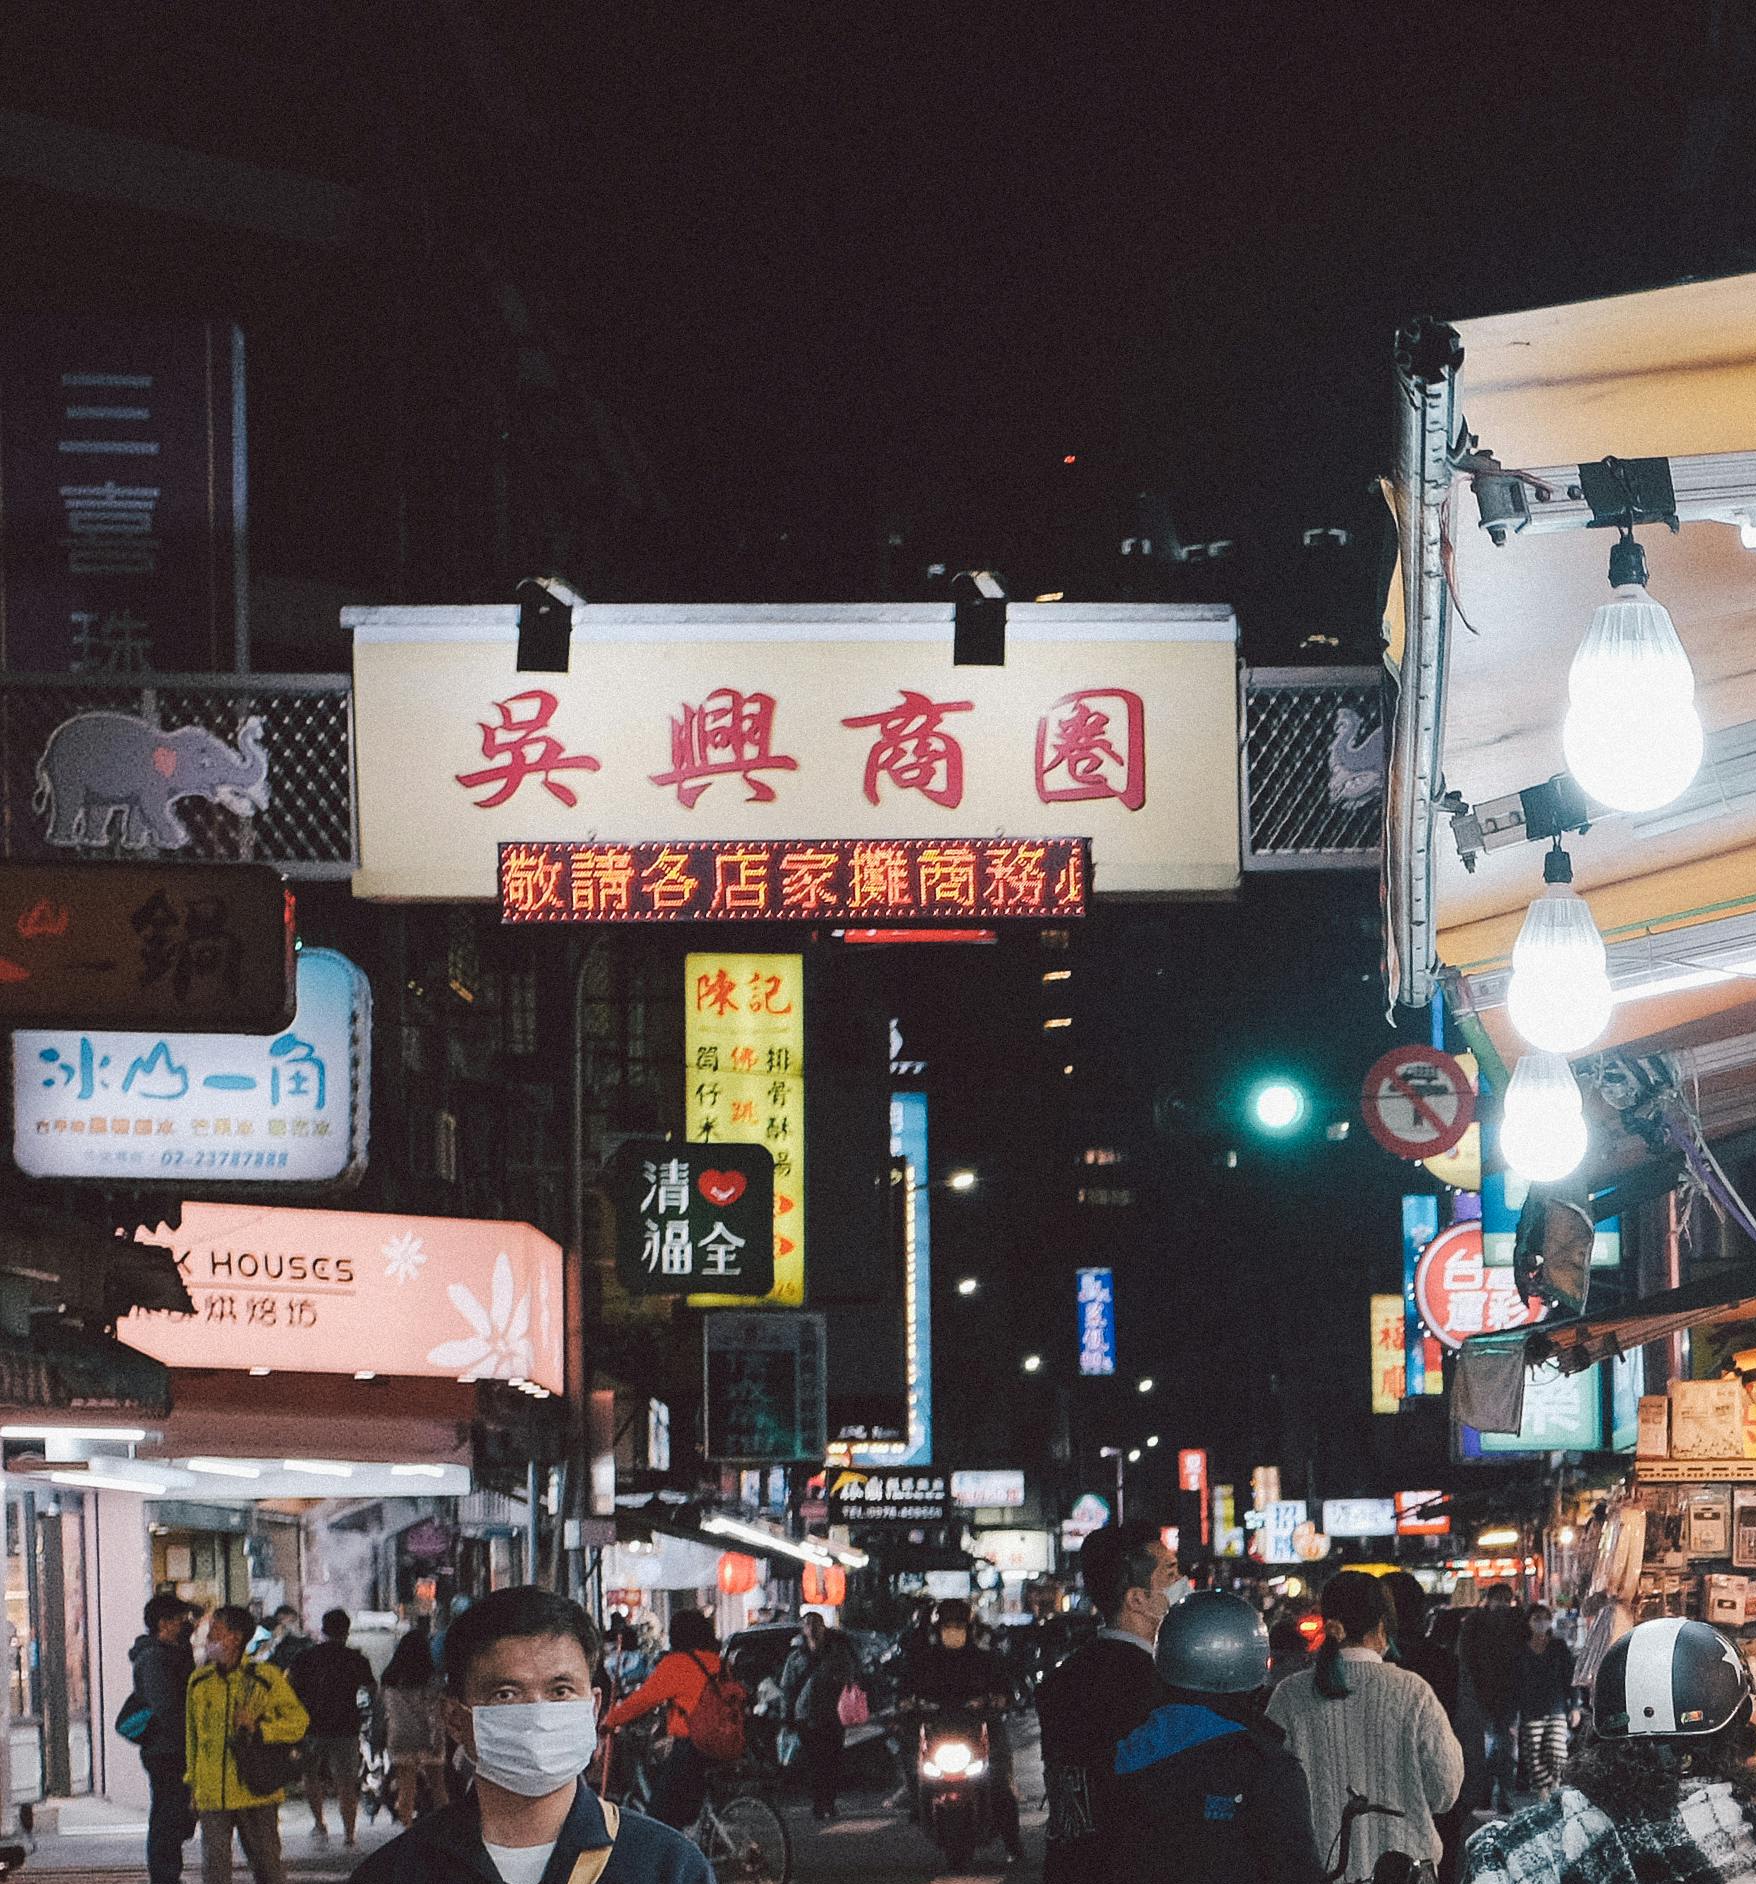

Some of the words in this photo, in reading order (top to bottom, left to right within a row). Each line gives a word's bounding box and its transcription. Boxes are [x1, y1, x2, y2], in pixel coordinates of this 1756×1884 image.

[455, 687, 1147, 811] 吳興商圈
[697, 968, 792, 1016] 陳記
[39, 1036, 327, 1112] 冰山一角
[211, 1251, 354, 1284] HOUSES
